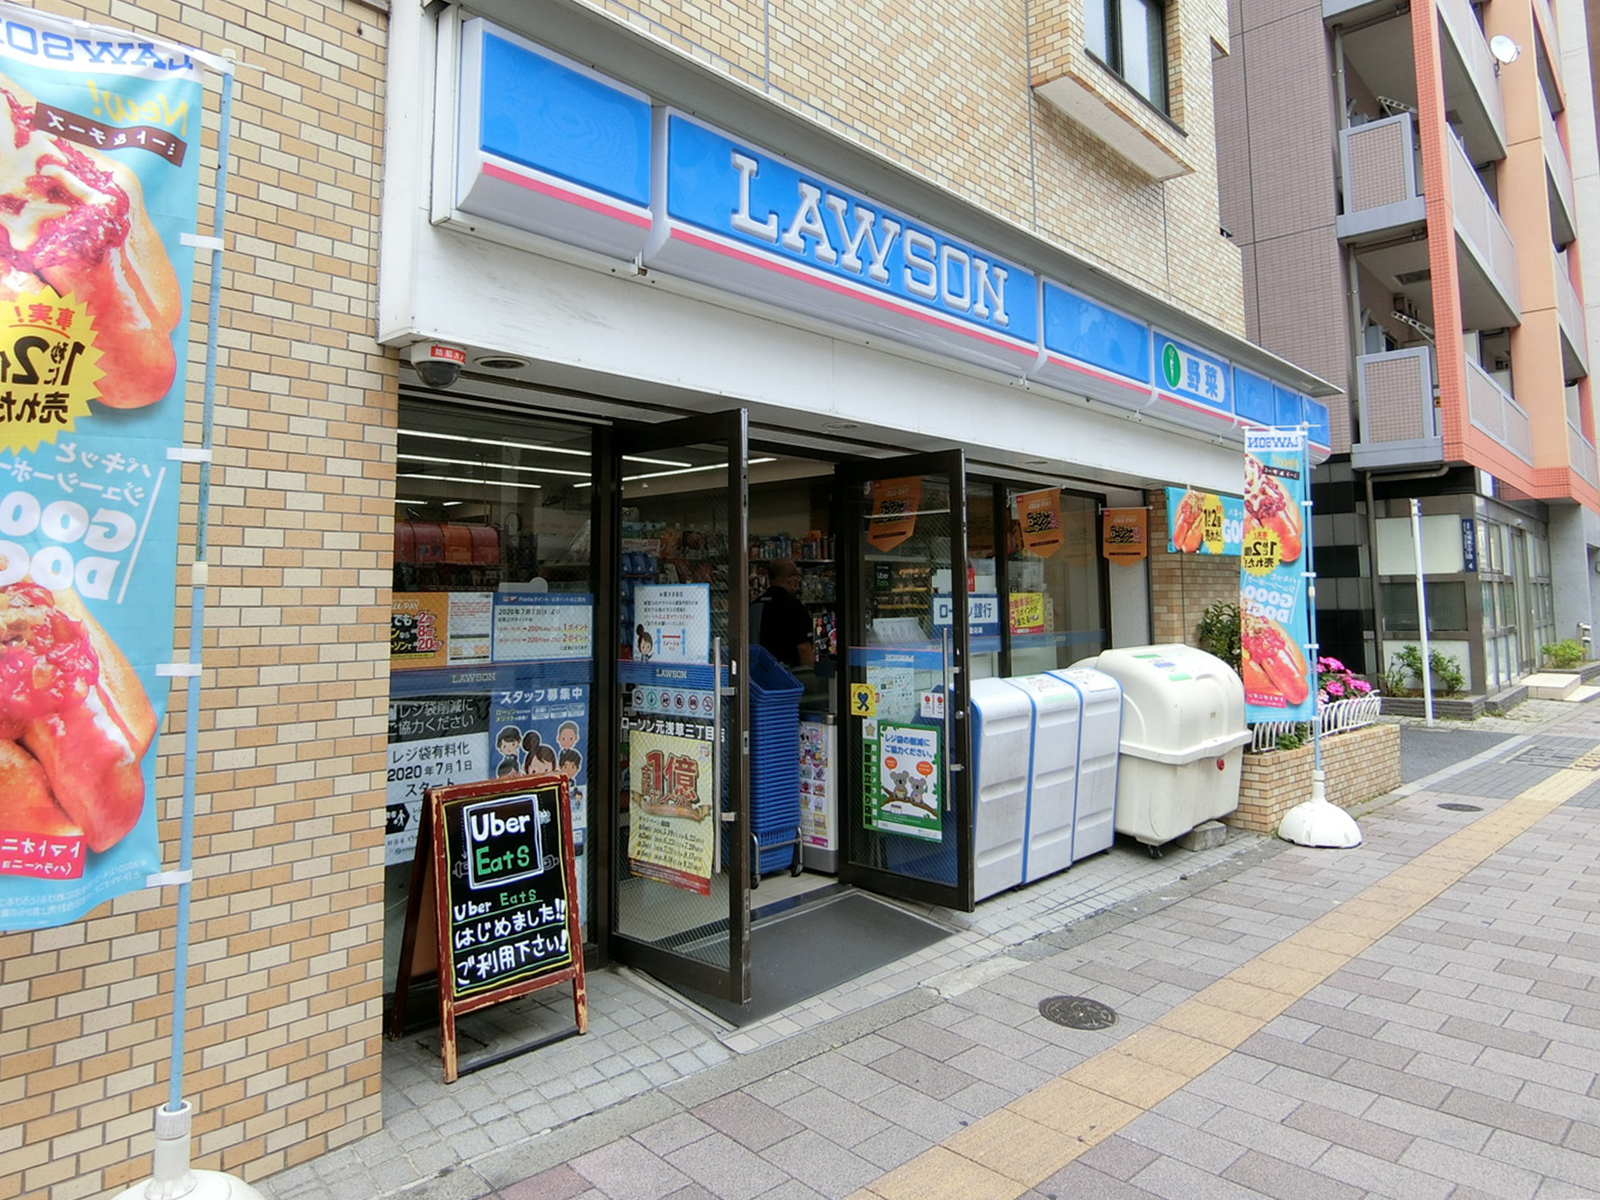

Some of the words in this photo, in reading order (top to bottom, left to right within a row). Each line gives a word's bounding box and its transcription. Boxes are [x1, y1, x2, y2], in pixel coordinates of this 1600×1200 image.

[731, 148, 1010, 327] LAWSON
[1186, 357, 1218, 398] 野菜
[452, 672, 497, 684] LAWSON
[656, 668, 688, 679] LAWSON
[399, 698, 475, 719] レジ袋削減に
[500, 687, 583, 705] スタッフ募集中
[393, 742, 471, 765] レジ袋有料化
[470, 812, 531, 842] Uber
[475, 845, 530, 876] Eats
[453, 900, 492, 921] Uber
[499, 889, 537, 907] Eats
[456, 929, 568, 986] ご利用下さい!
